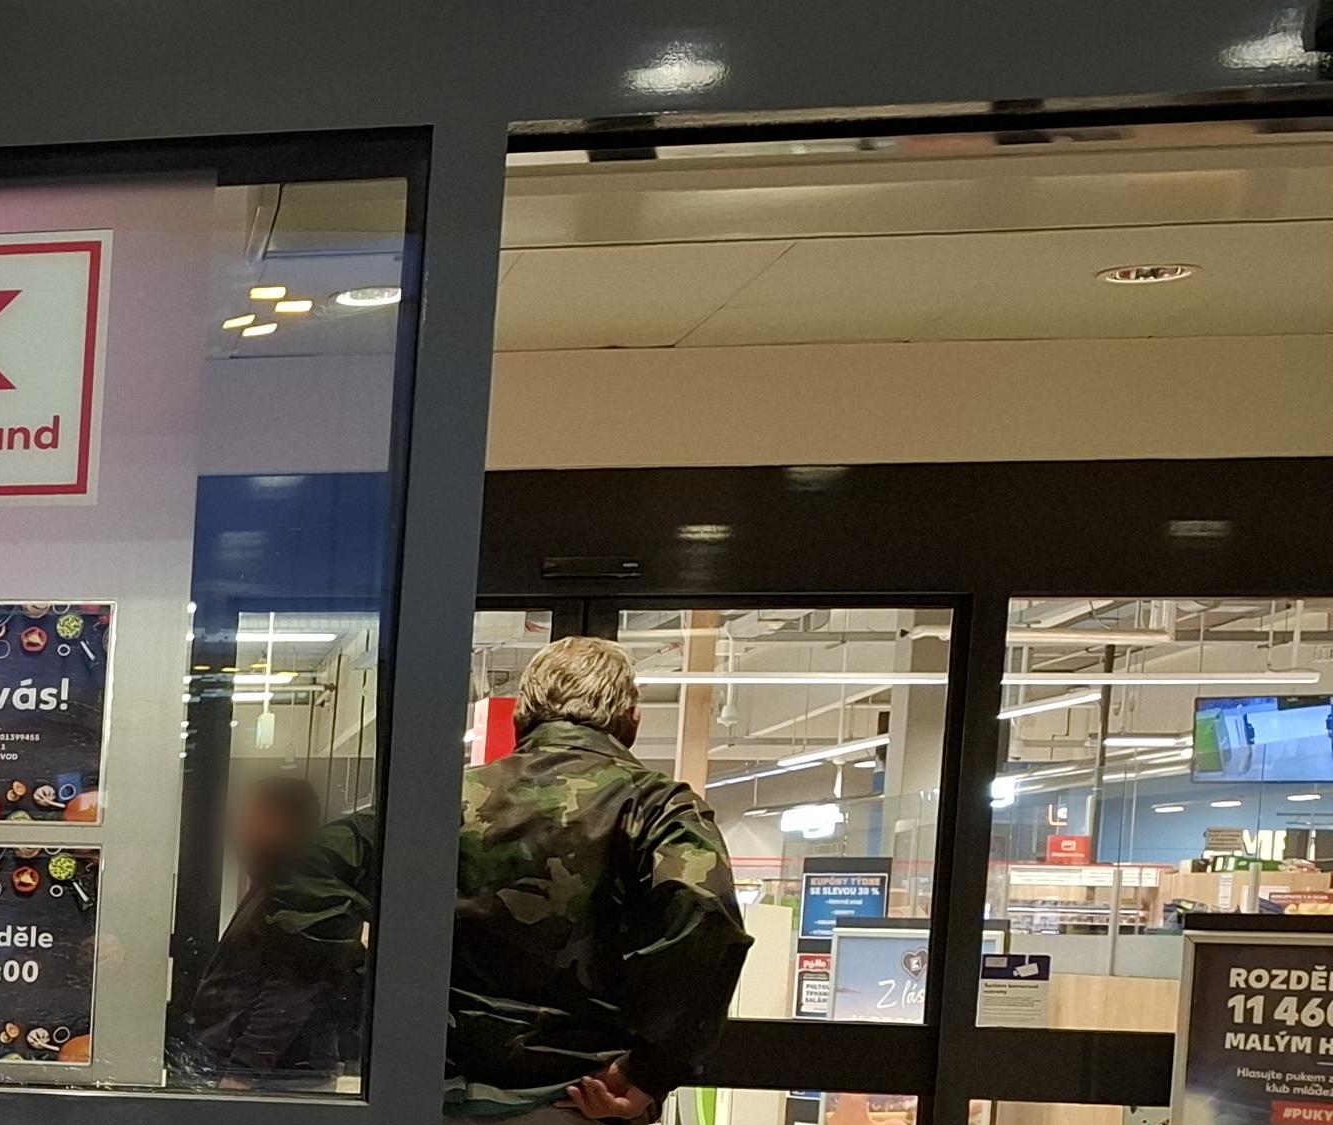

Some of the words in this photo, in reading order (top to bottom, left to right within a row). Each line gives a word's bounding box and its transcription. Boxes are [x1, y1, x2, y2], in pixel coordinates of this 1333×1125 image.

[810, 887, 820, 895] SE
[822, 887, 856, 895] SLEVOU
[1228, 994, 1265, 1024] 11
[1273, 996, 1333, 1028] 46
[1224, 1031, 1312, 1055] MALÝM
[1237, 1067, 1283, 1080] Hlasujte
[1285, 1071, 1325, 1083] pukem
[1265, 1082, 1290, 1094] klub
